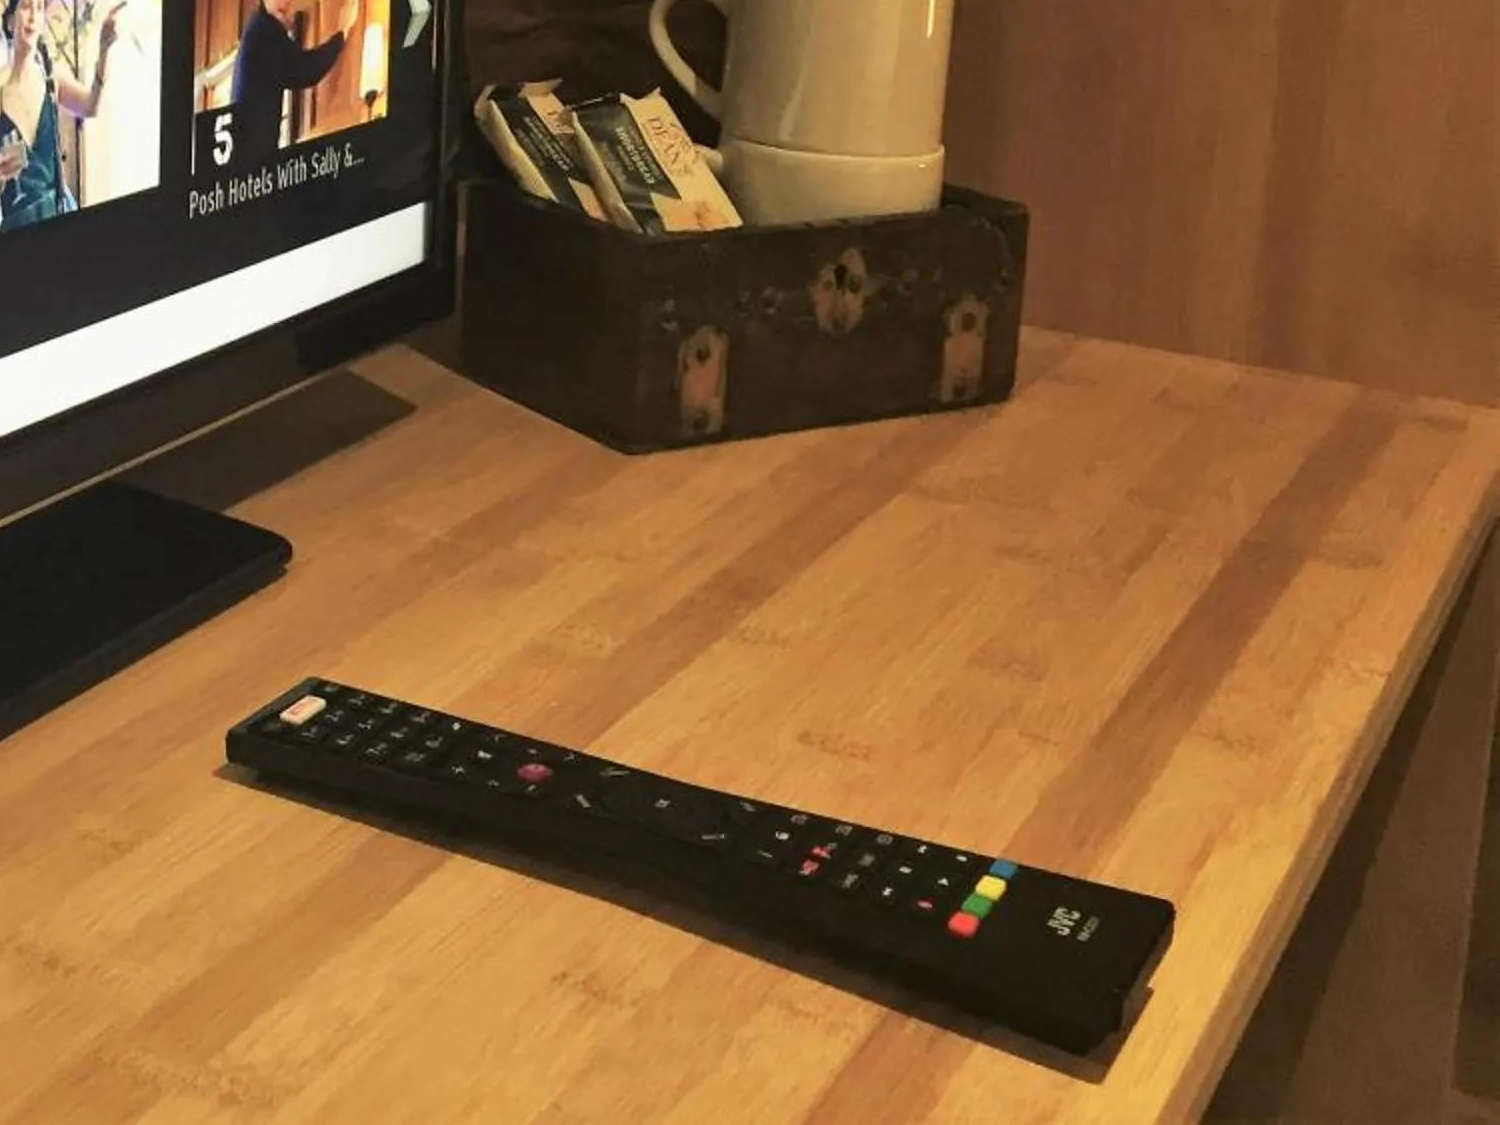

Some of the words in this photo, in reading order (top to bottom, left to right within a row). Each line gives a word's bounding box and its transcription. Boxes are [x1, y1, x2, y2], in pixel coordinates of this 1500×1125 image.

[211, 111, 234, 167] 5
[188, 180, 225, 220] Posh
[228, 166, 273, 207] Hotels
[276, 155, 307, 191] With
[311, 144, 341, 180] Sally
[1047, 906, 1081, 937] JVC
